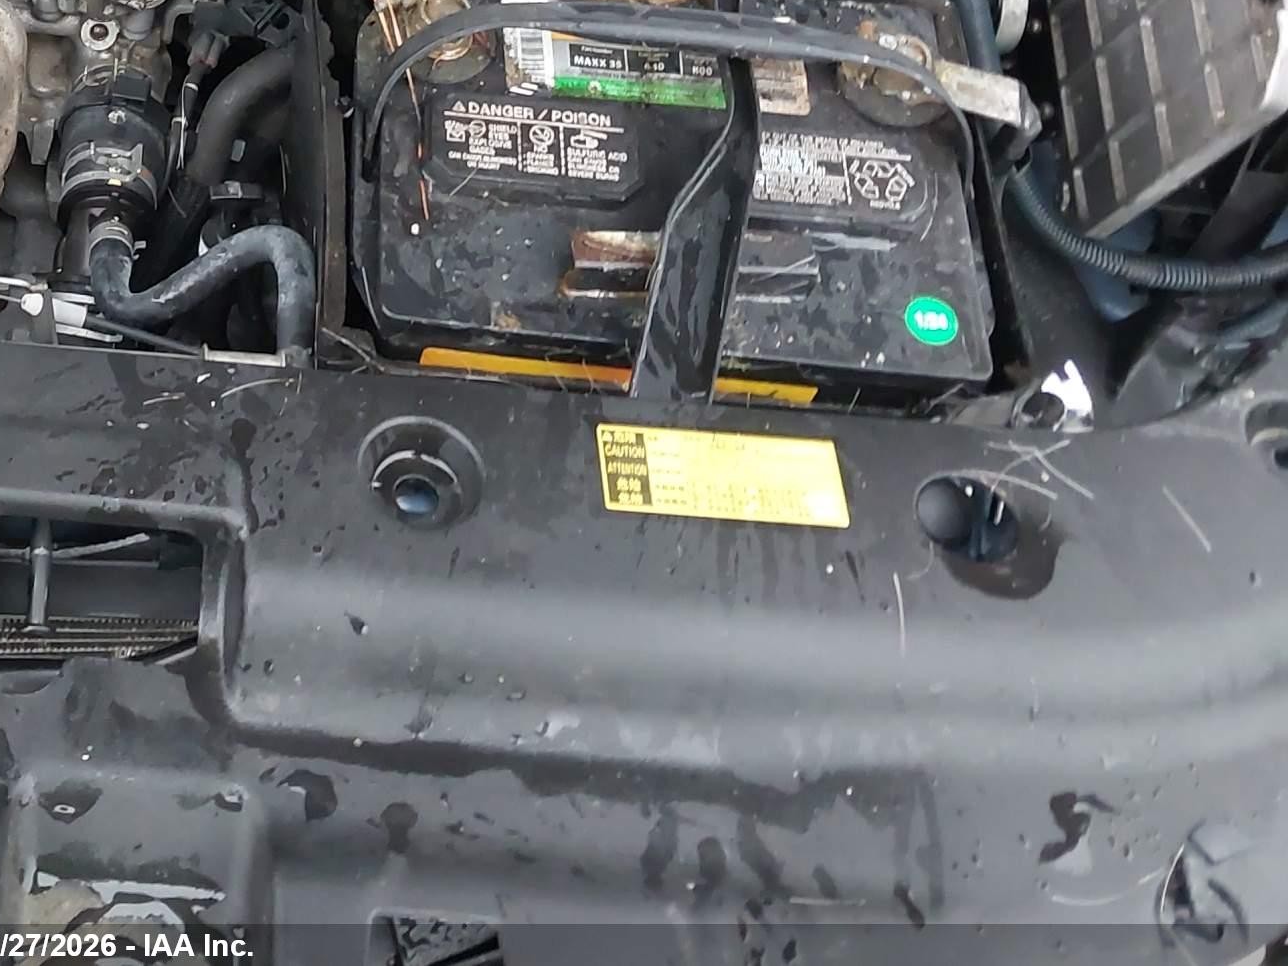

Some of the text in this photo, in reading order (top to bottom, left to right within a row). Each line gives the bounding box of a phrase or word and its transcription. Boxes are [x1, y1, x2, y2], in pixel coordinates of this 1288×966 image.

[574, 54, 606, 68] MAXX
[468, 101, 534, 120] DANGER
[551, 109, 611, 127] POISON
[604, 443, 645, 459] CAUTION
[607, 461, 648, 477] ATTENTION
